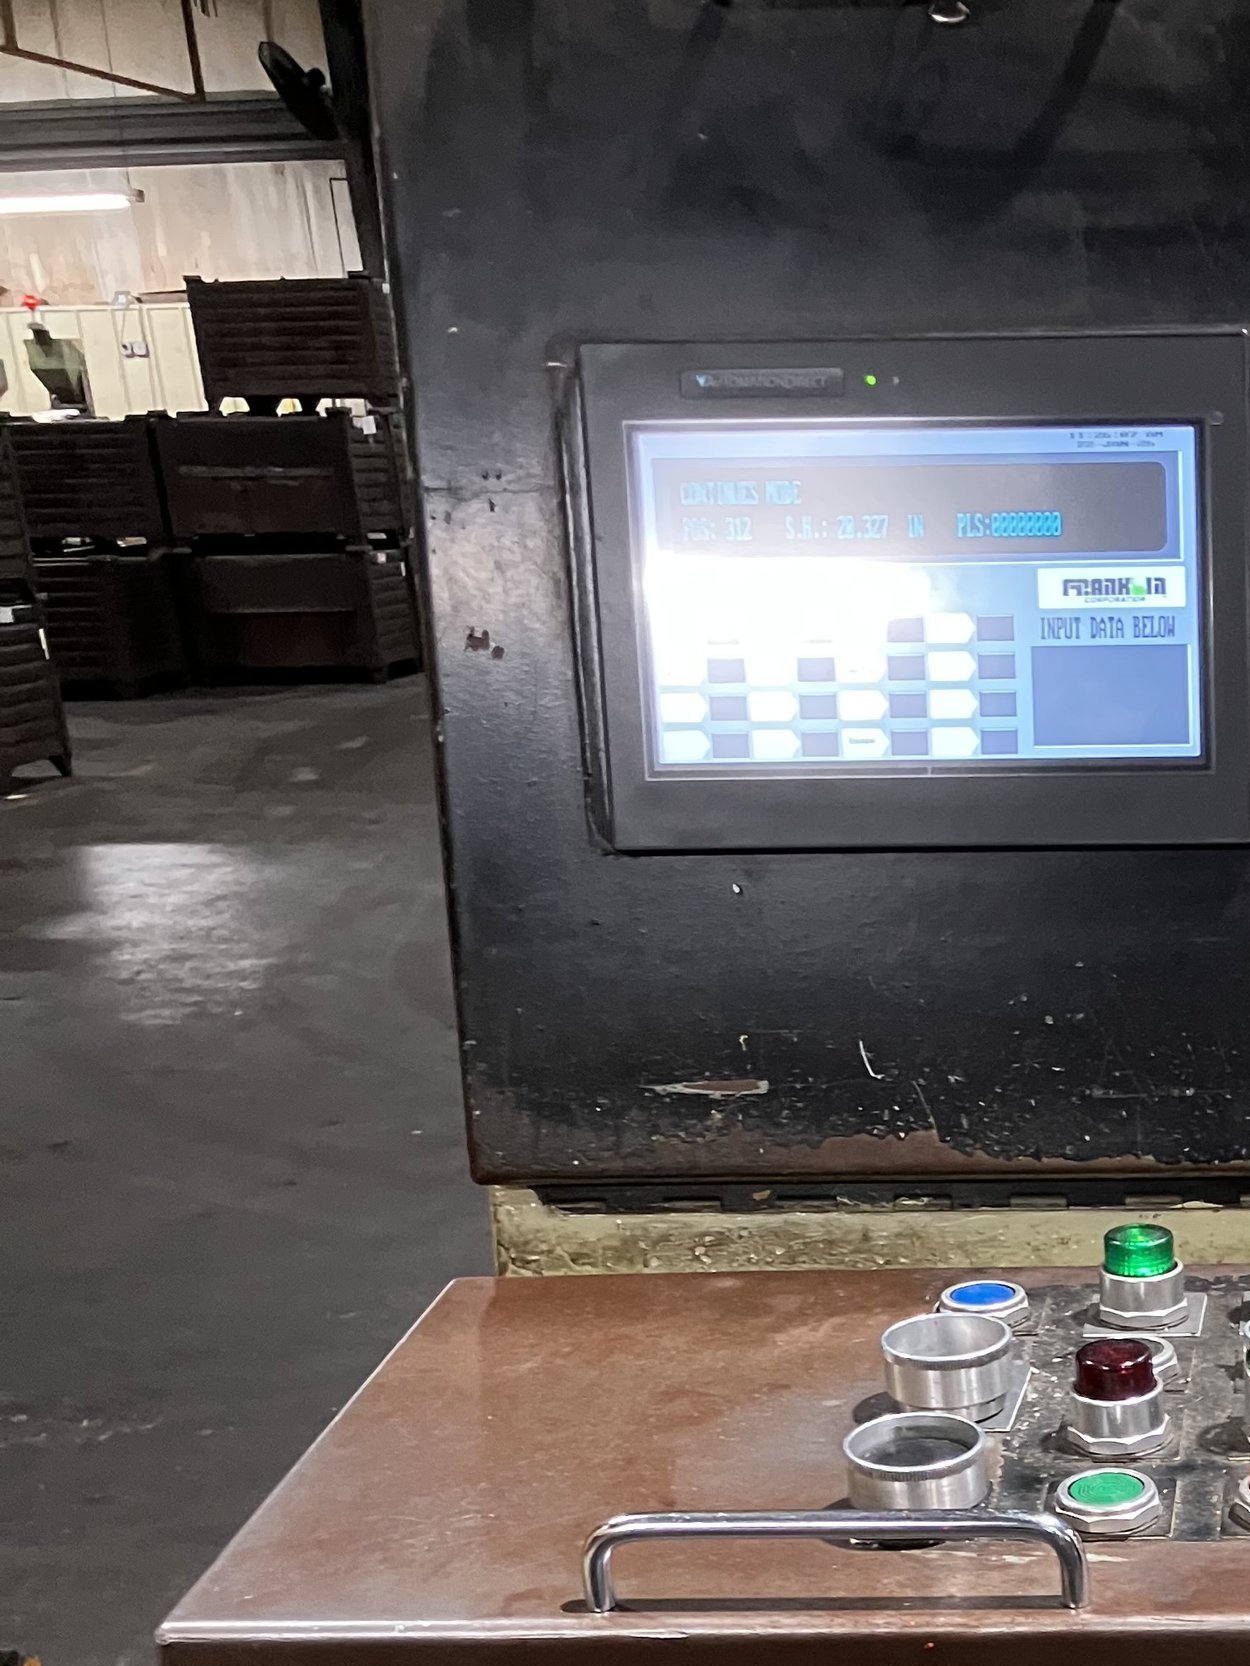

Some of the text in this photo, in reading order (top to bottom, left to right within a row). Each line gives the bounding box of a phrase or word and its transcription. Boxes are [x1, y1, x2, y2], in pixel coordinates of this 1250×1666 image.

[725, 516, 752, 540] 312
[1041, 615, 1175, 640] INPUT DATA BELOW
